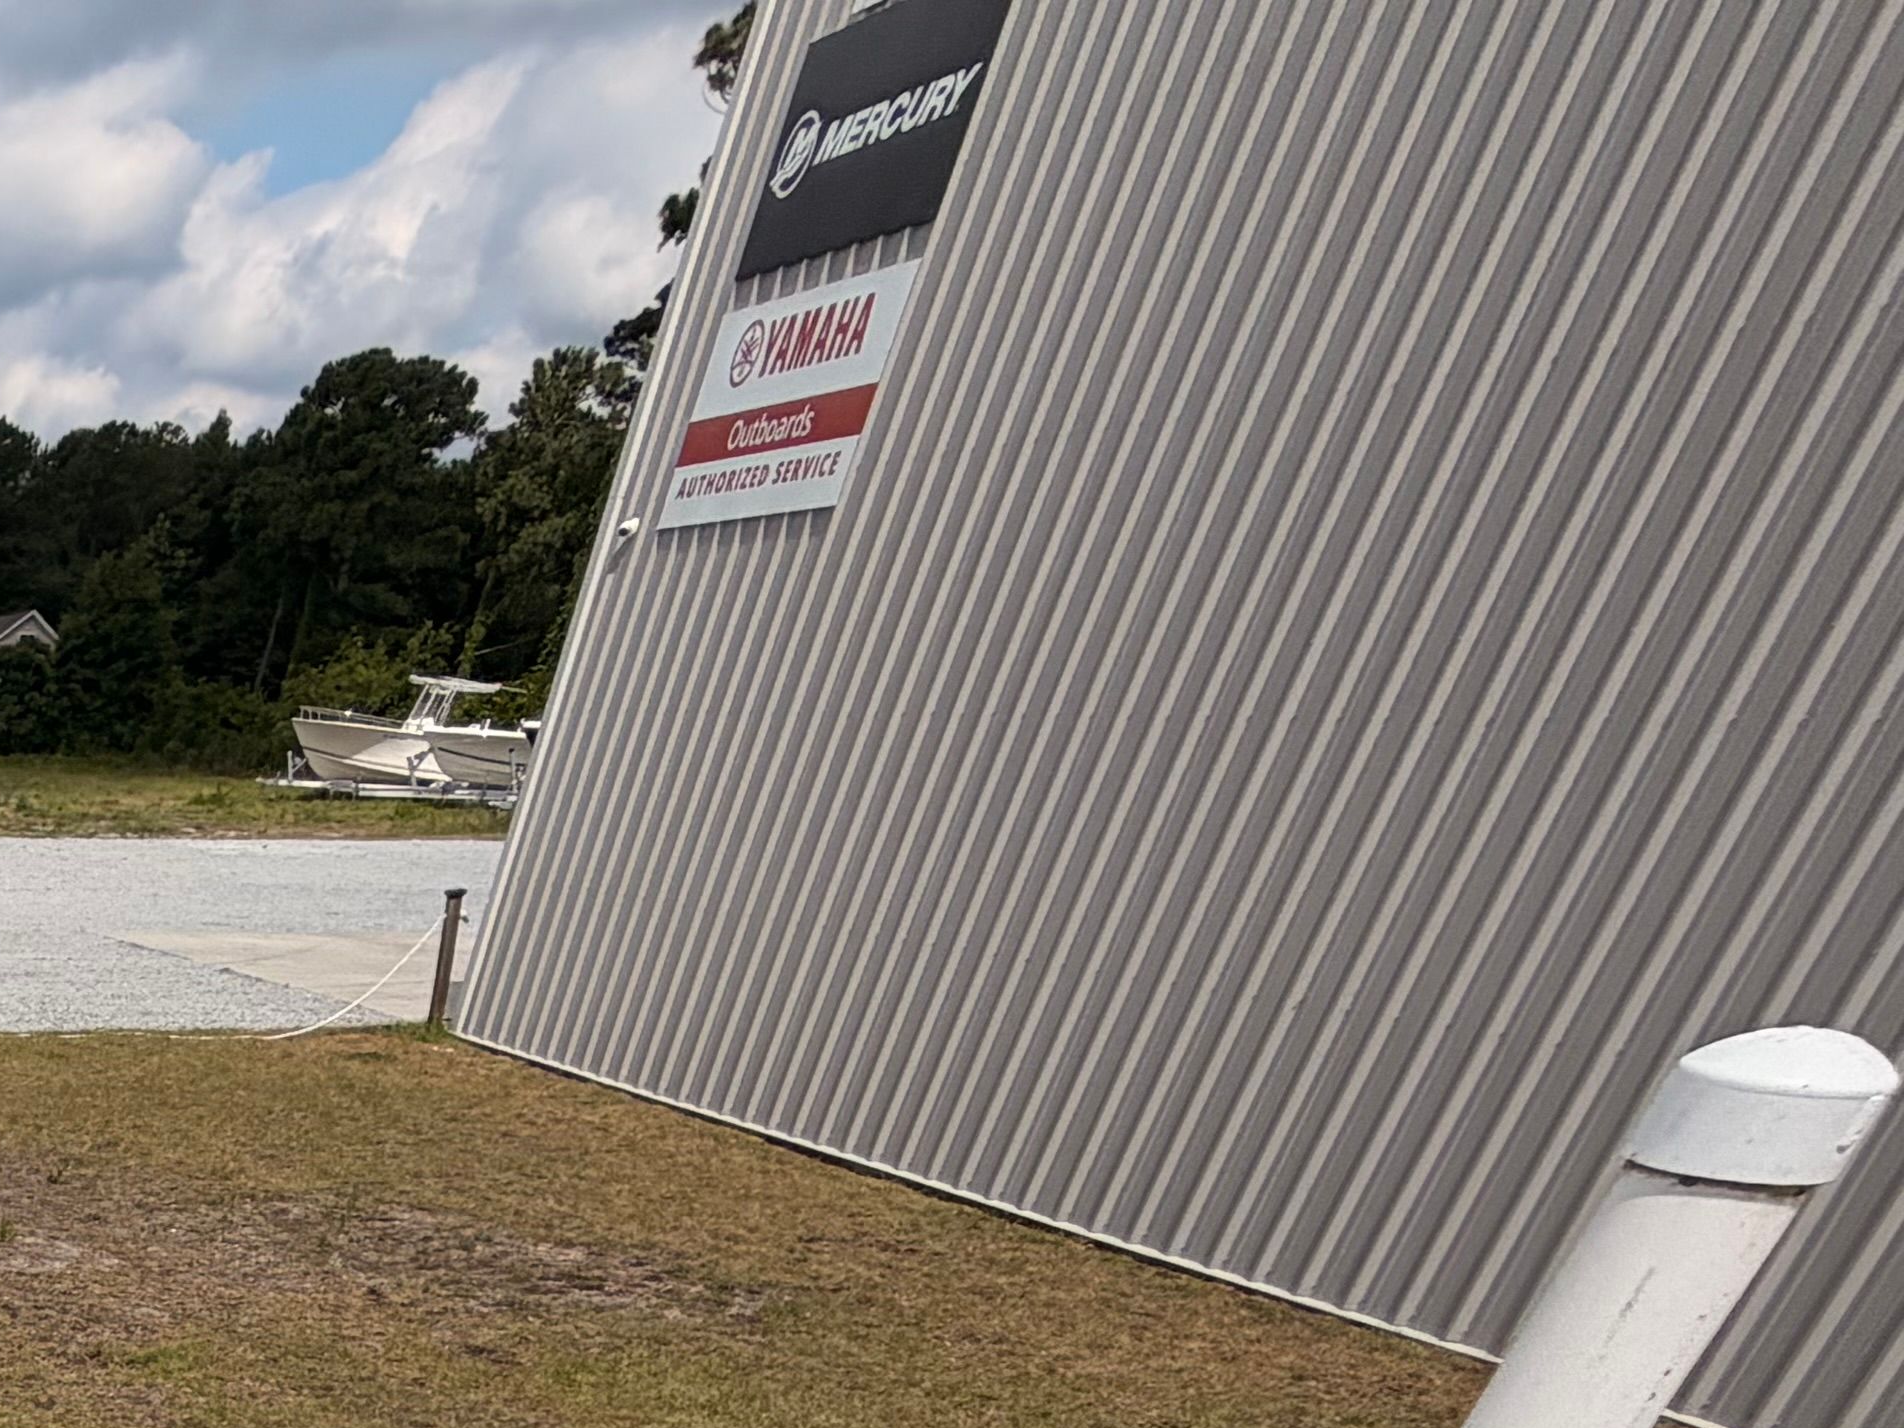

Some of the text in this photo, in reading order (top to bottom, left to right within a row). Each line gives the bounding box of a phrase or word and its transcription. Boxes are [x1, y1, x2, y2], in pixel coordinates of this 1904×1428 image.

[813, 61, 984, 165] MERCURY
[757, 292, 877, 378] YAMAHA
[727, 403, 815, 451] Outboards
[676, 450, 842, 499] AUTHORIZED SERVICE
